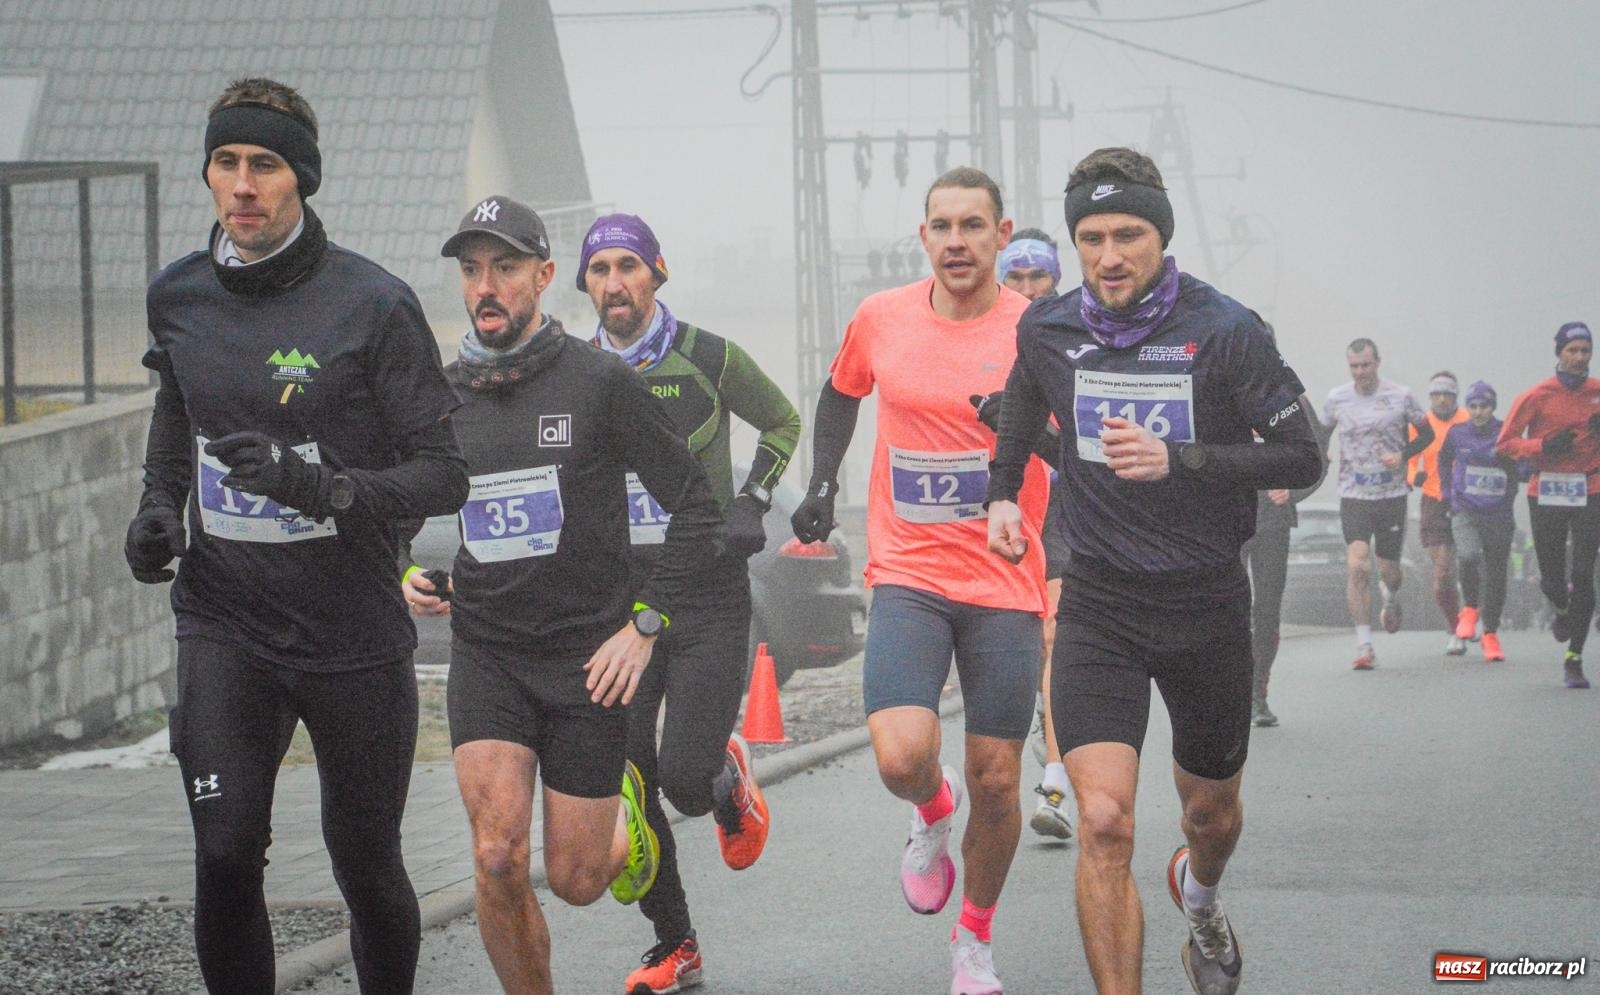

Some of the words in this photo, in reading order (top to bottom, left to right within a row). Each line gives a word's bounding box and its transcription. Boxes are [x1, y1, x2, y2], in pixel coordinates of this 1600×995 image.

[1096, 184, 1116, 194] NIKE
[473, 200, 500, 222] NY
[1138, 353, 1194, 361] MARATHON
[279, 366, 307, 375] ANTCZAK
[1094, 401, 1171, 438] 116
[1280, 402, 1300, 419] asics
[543, 420, 567, 441] all
[916, 474, 961, 503] 12
[1548, 480, 1577, 494] 135
[486, 498, 530, 536] 35
